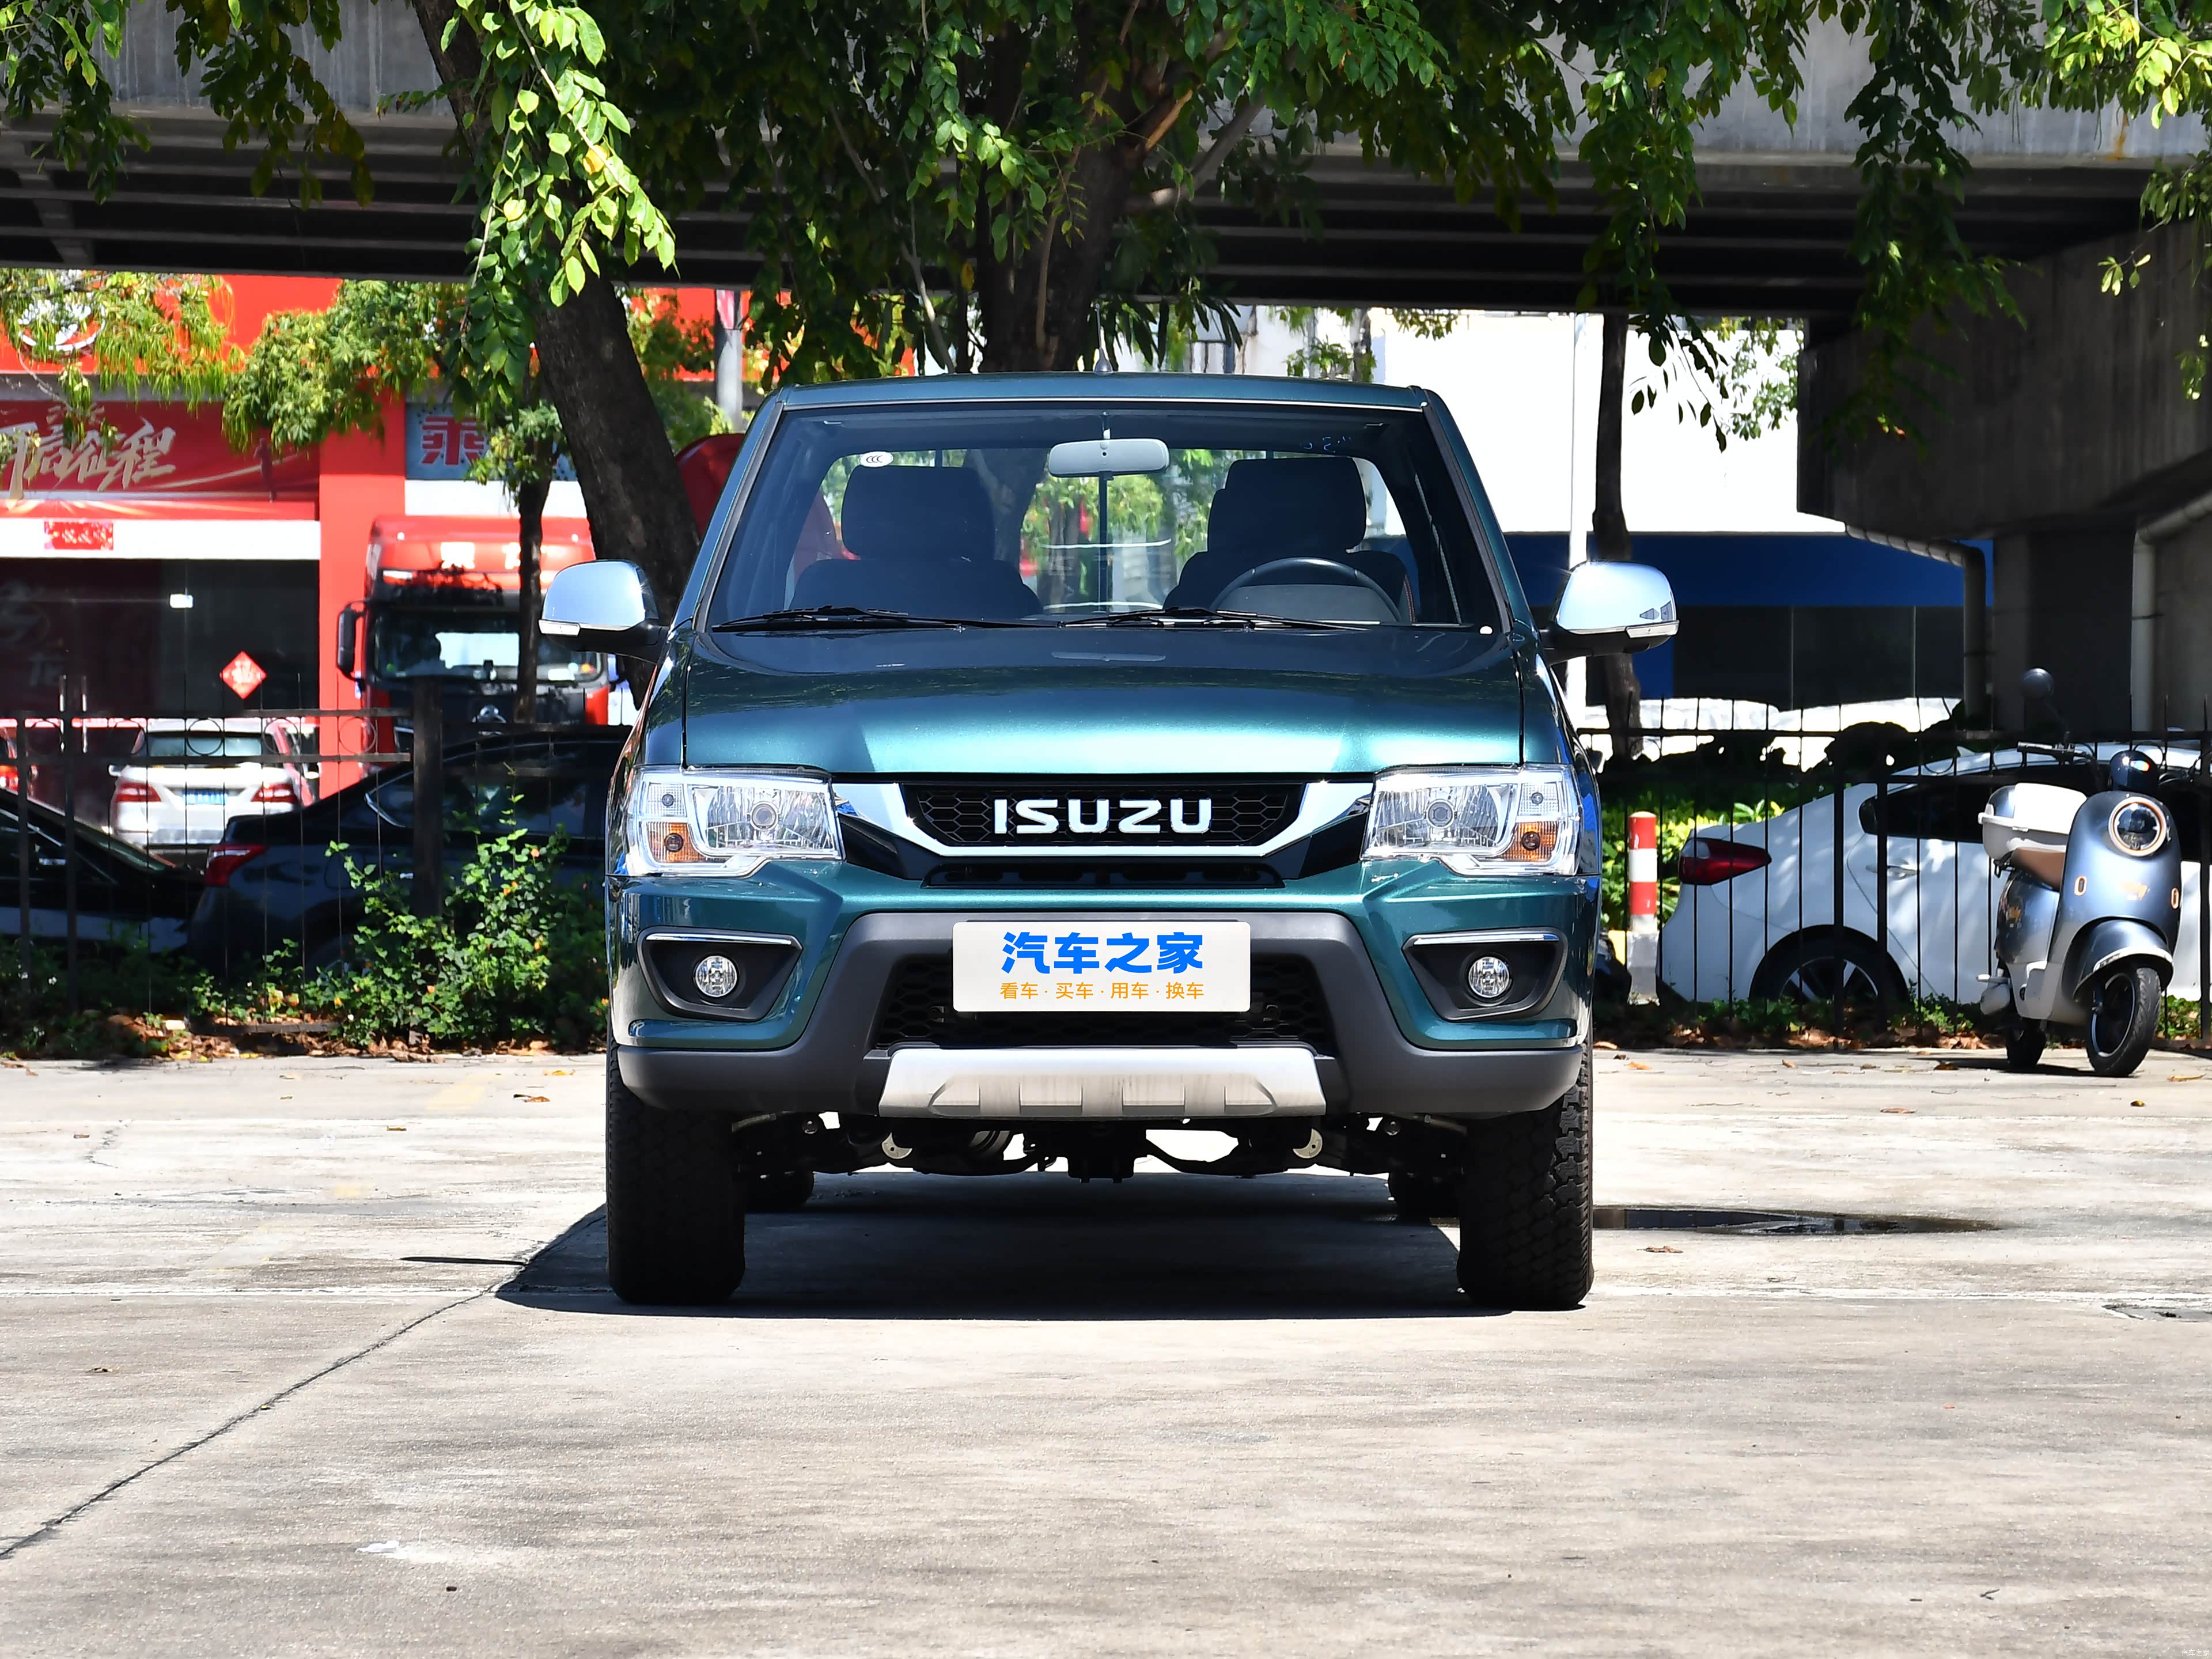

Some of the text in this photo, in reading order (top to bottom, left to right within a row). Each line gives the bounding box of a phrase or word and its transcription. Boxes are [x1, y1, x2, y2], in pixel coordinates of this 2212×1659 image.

[995, 799, 1211, 833] ISUZU
[1002, 932, 1202, 974] 汽车之家
